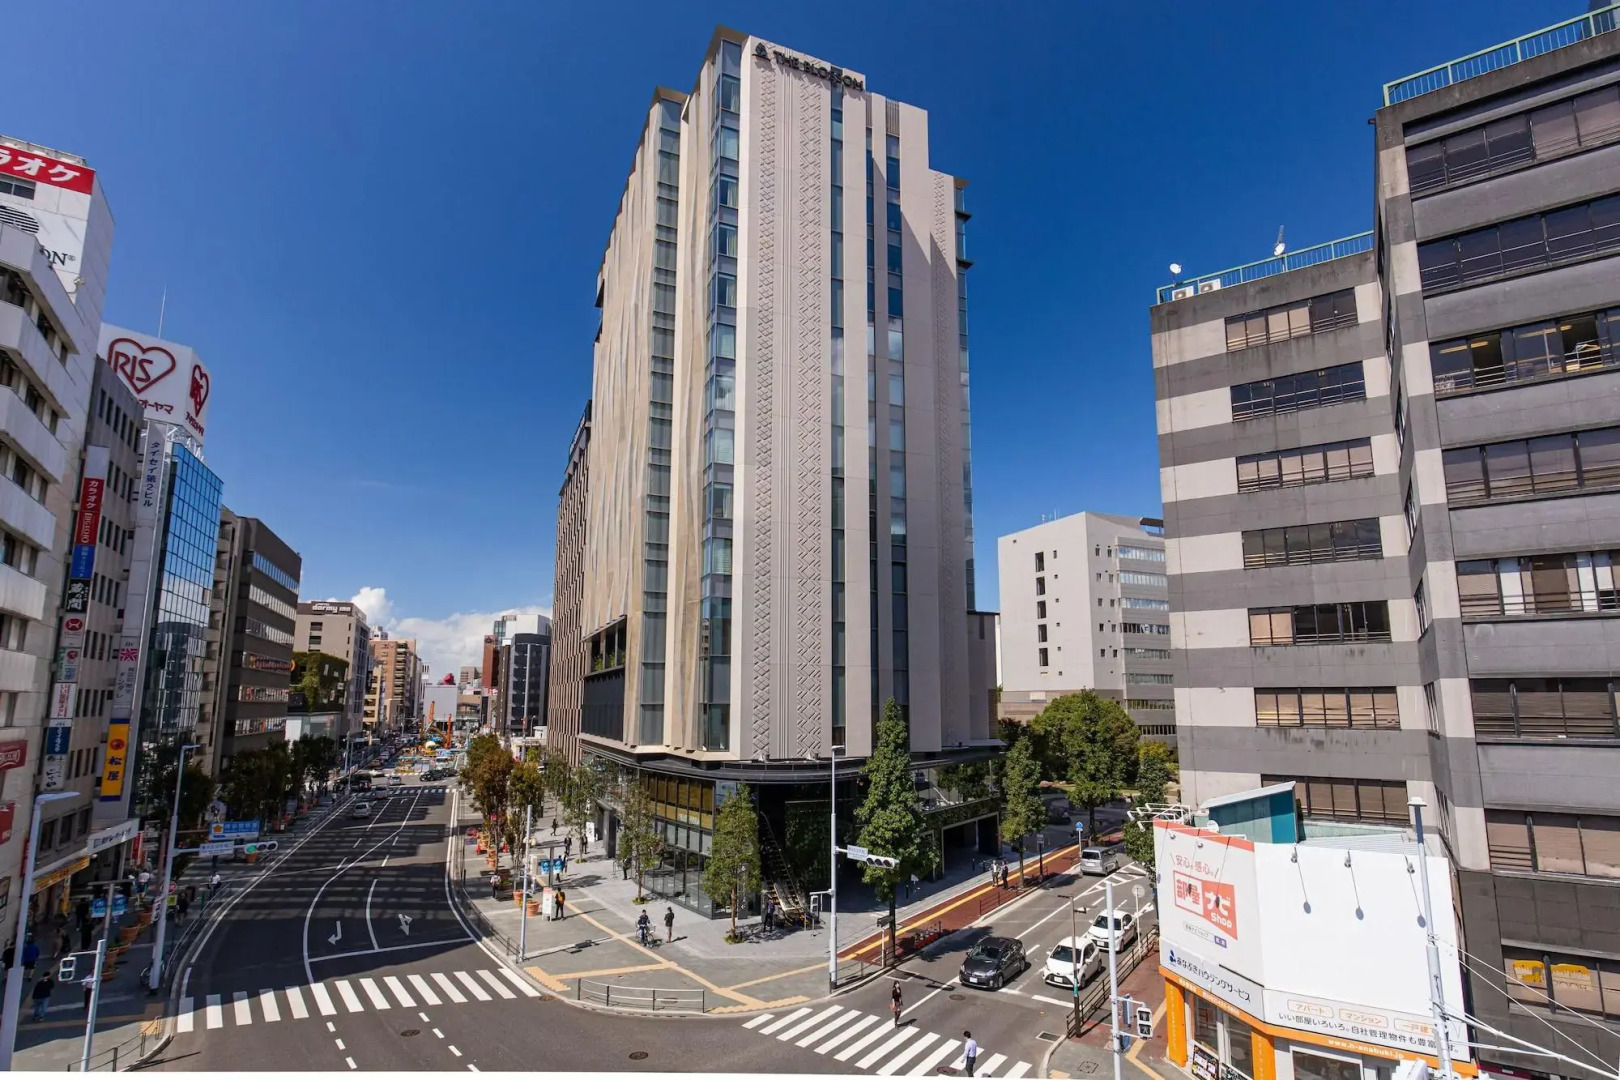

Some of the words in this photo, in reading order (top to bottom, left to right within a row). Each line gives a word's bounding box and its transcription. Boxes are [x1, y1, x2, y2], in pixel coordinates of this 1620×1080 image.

[773, 50, 800, 70] THE
[803, 60, 864, 91] BLOSSOM
[106, 755, 122, 781] 松屋
[1176, 957, 1251, 1003] あなぶきハウジングサービス
[1296, 1003, 1325, 1014] アパート
[1345, 1013, 1382, 1025] マンション
